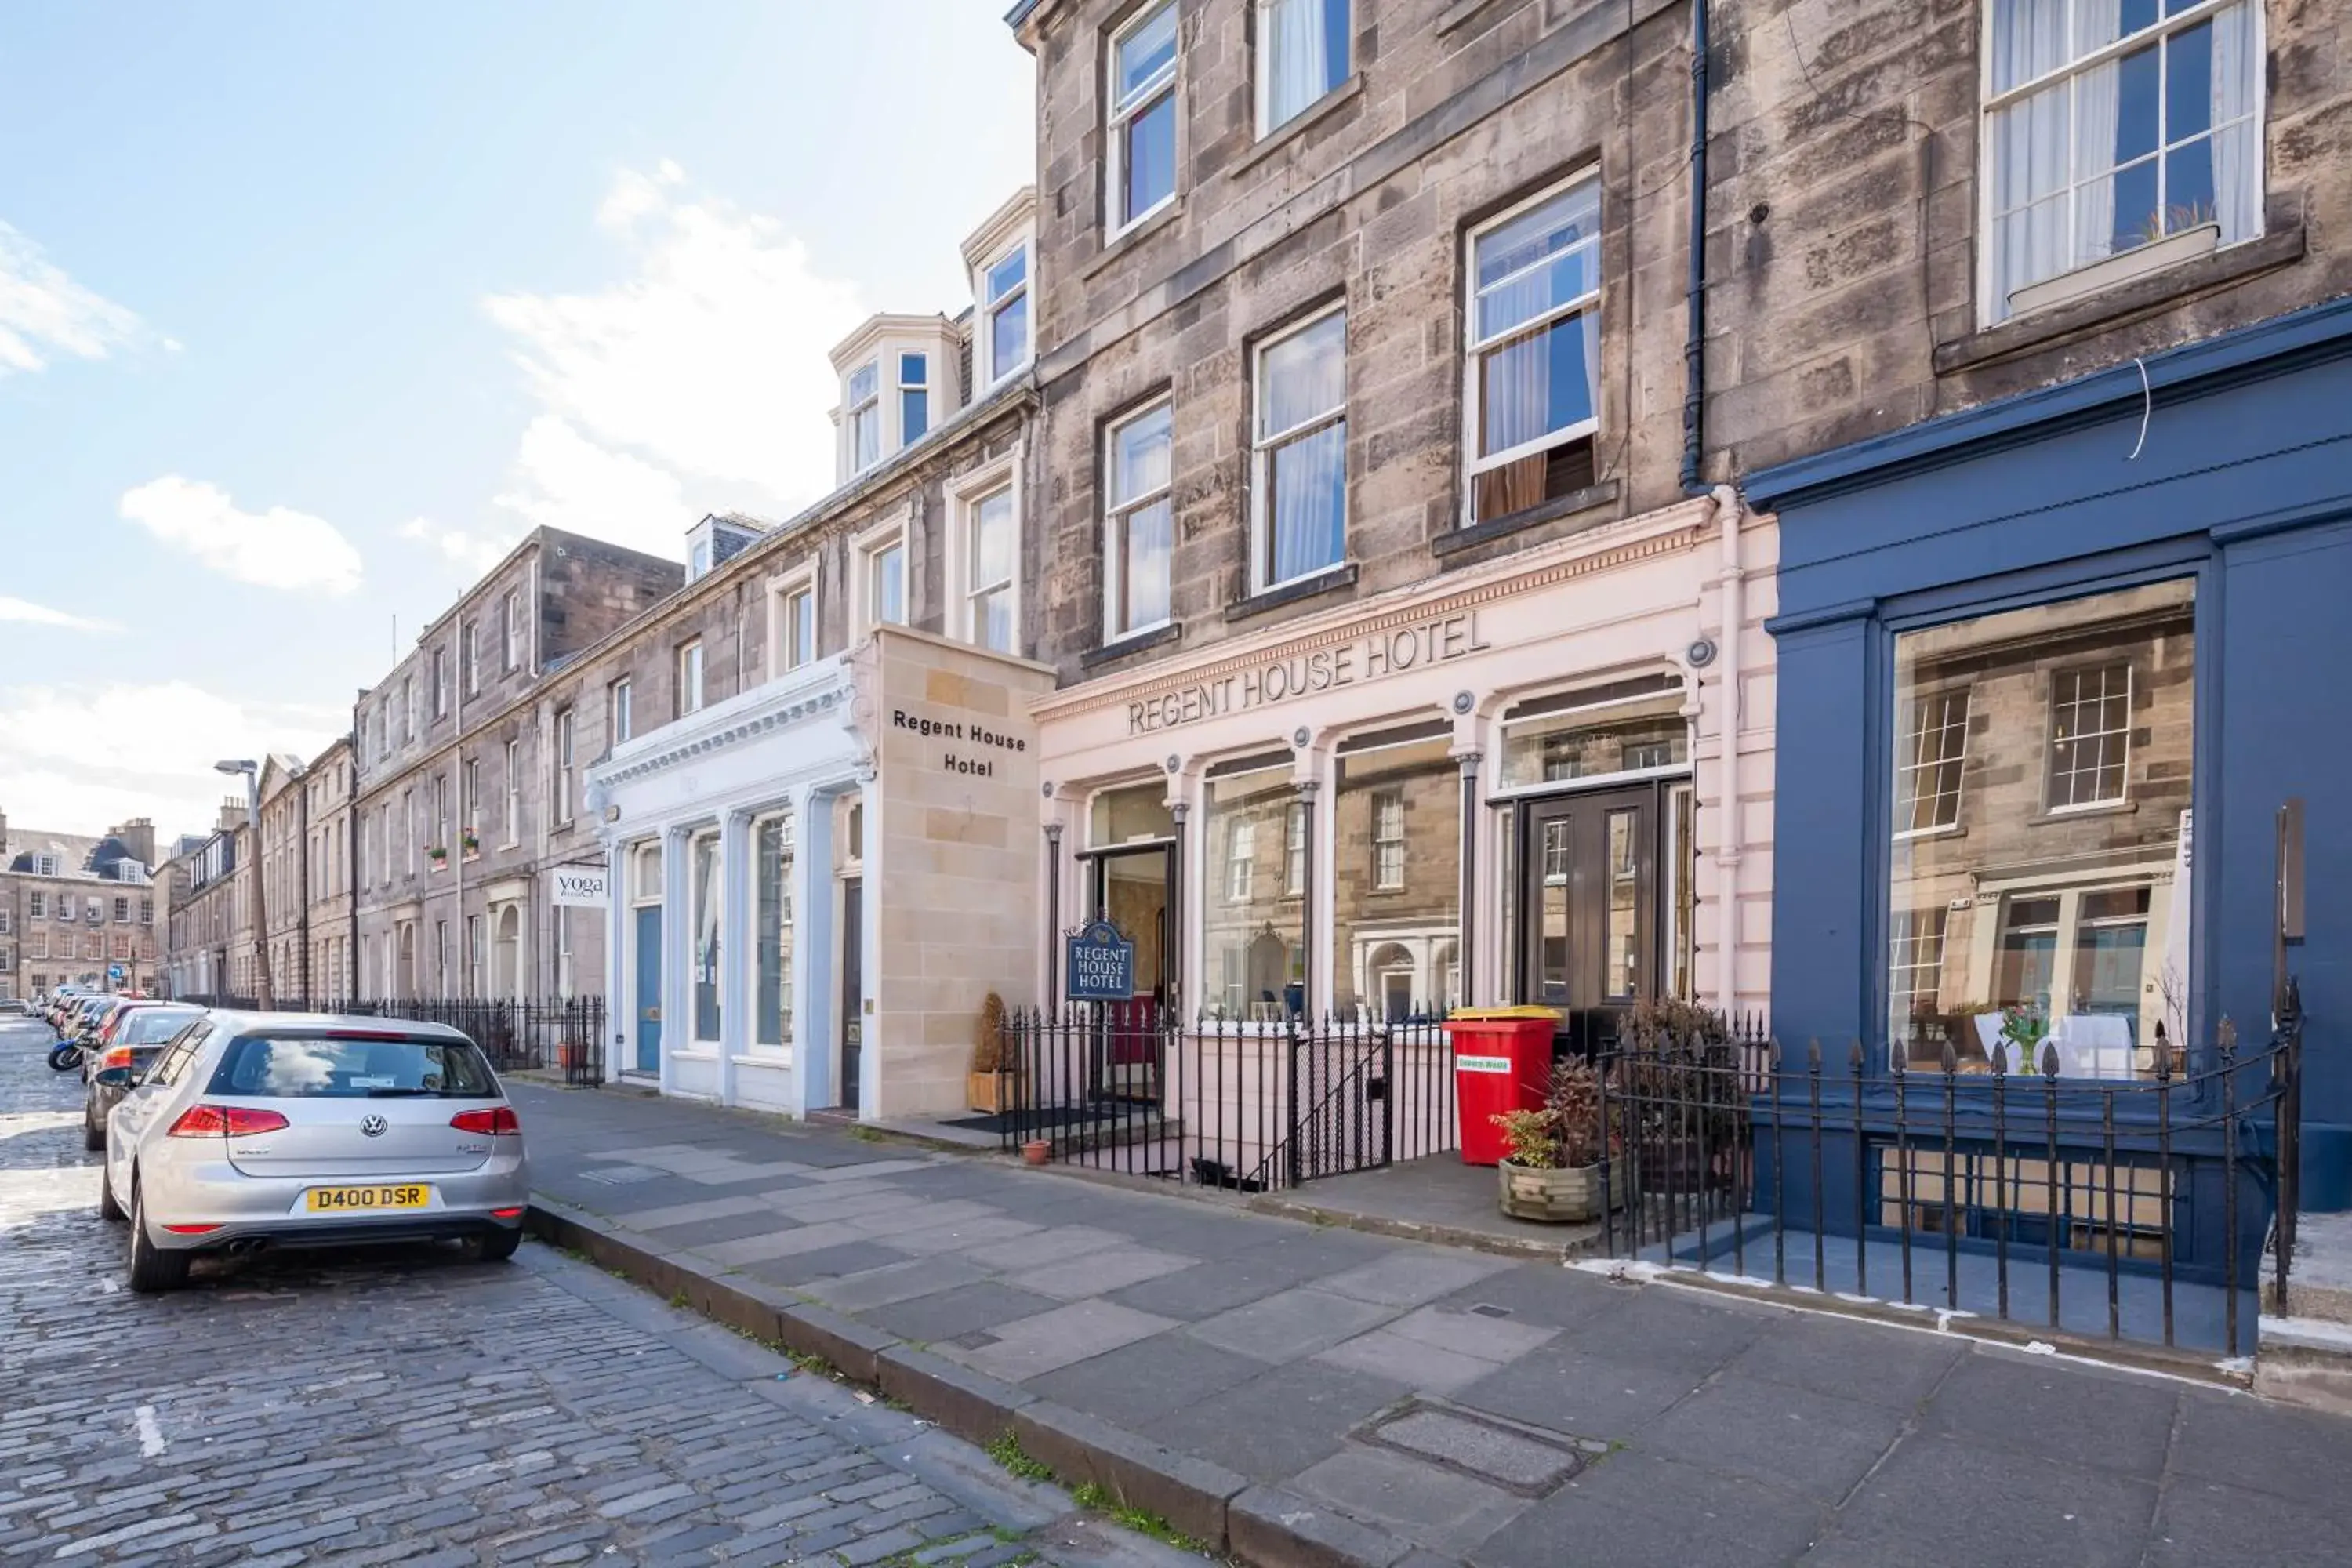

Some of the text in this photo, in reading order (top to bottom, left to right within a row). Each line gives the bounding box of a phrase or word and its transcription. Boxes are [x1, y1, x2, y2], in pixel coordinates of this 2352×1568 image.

[1127, 612, 1490, 735] REGENT HOUSE HOTEL
[894, 710, 1025, 751] Regent House
[944, 753, 993, 777] Hotel
[559, 877, 603, 898] yoga
[1075, 946, 1127, 962] REGENT
[1078, 960, 1124, 975] HOUSE
[1079, 975, 1123, 989] HOTEL
[318, 1187, 420, 1207] D400 DSR
